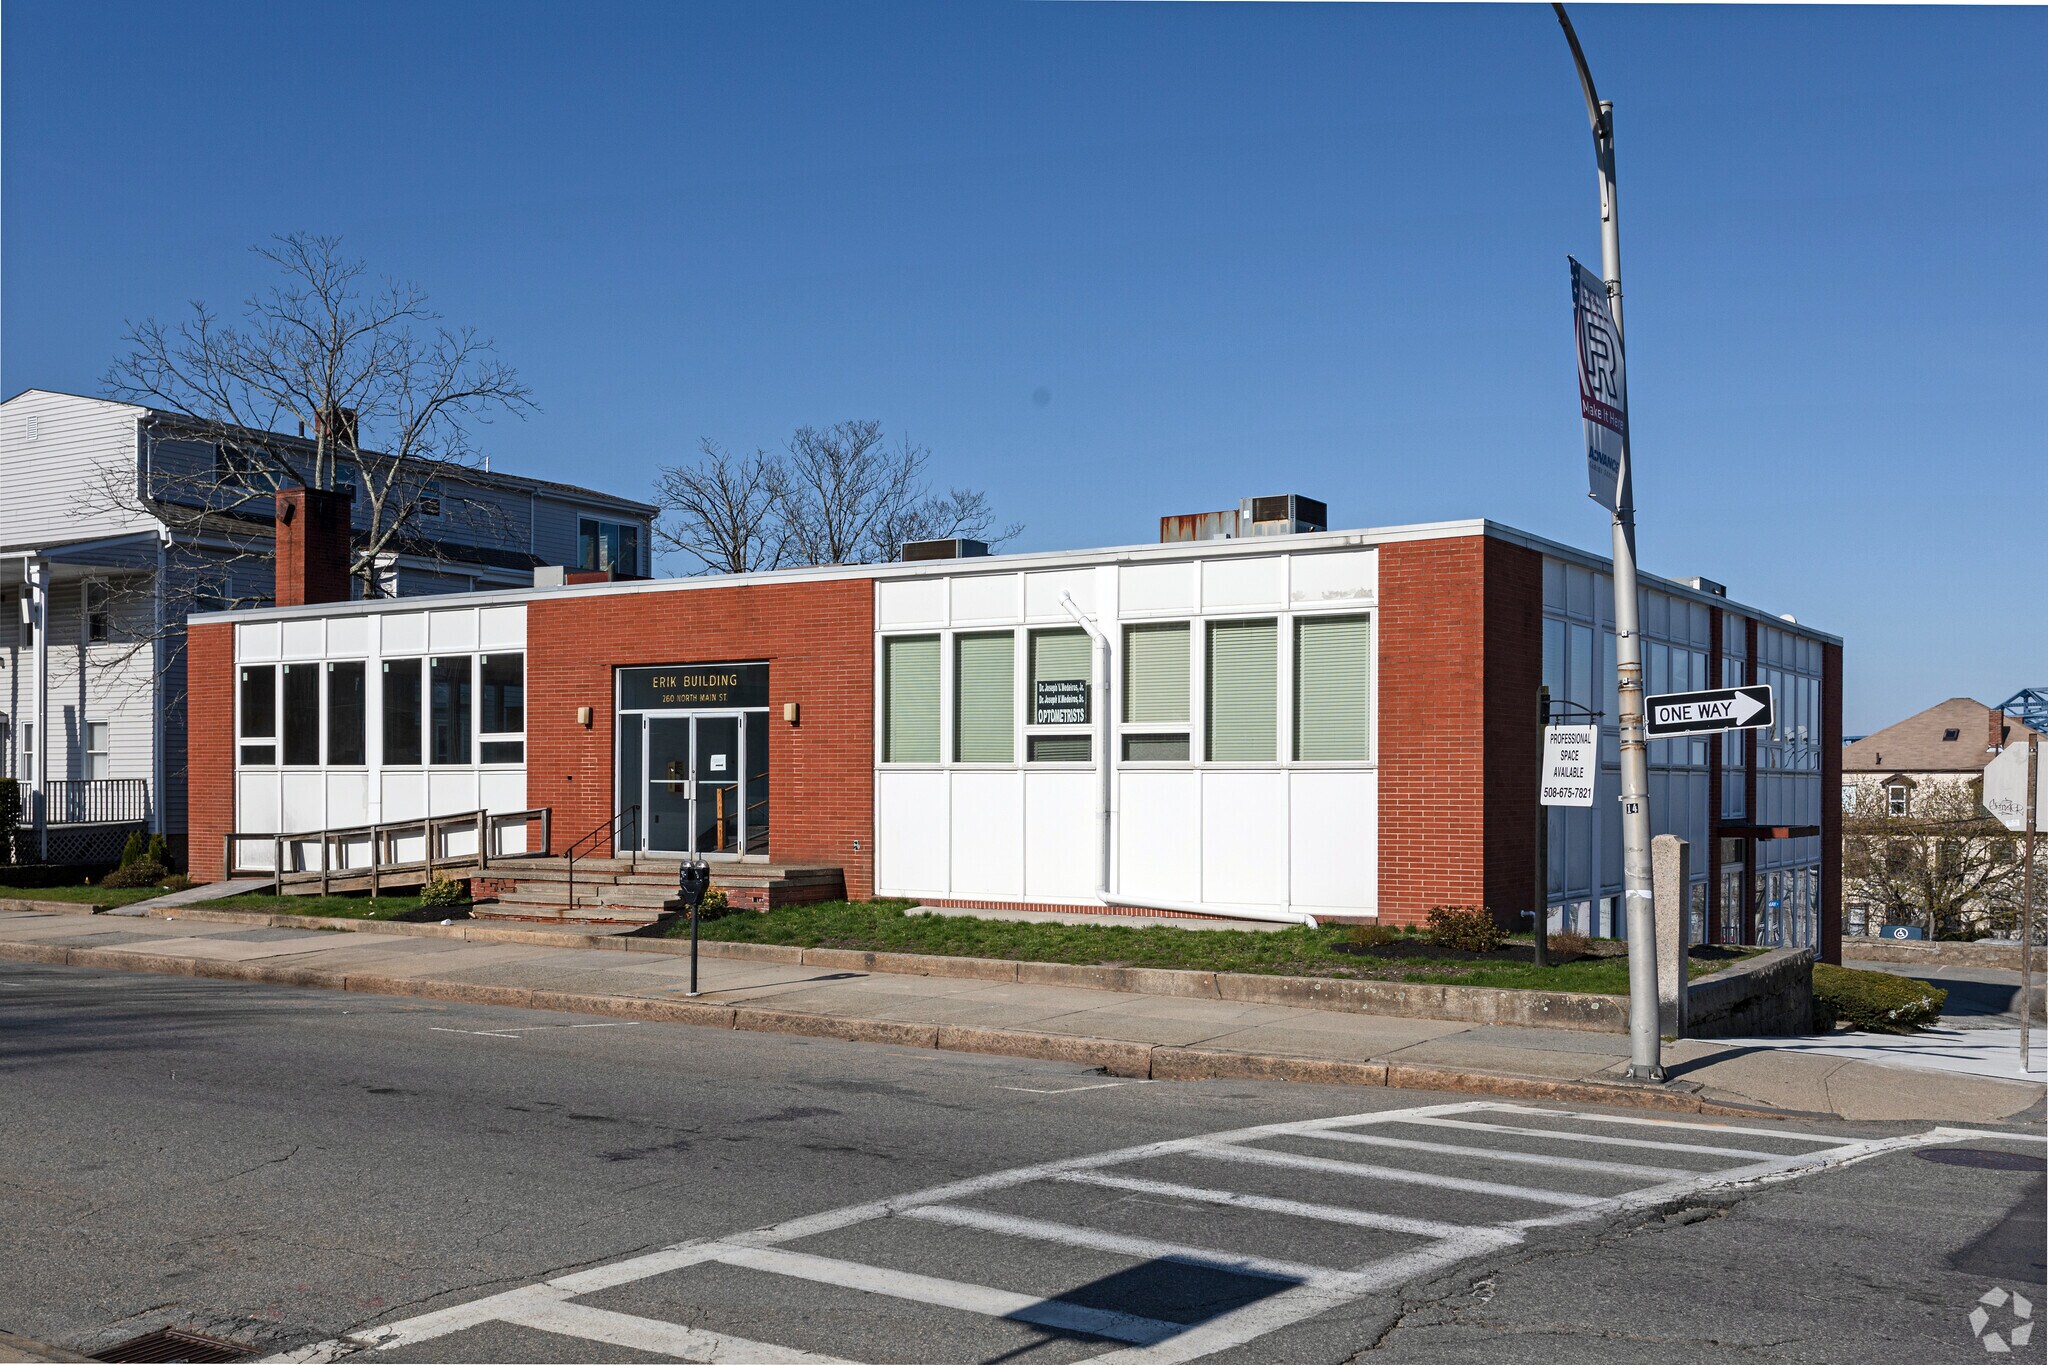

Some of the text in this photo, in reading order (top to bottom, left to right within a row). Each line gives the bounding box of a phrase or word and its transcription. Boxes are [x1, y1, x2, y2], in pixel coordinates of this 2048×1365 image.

[1582, 399, 1602, 420] Make
[1609, 412, 1624, 431] Here
[652, 674, 737, 688] ERIK BUILDING
[662, 694, 675, 703] 260
[677, 693, 698, 702] NORTH
[699, 693, 717, 702] MAIN
[1038, 708, 1085, 723] OPTOMETRISTS
[1660, 701, 1732, 722] ONE WAY
[1550, 733, 1591, 744] PROFESSIONAL
[1560, 749, 1579, 761] SPACE
[1553, 766, 1584, 778] AVAILABLE
[1543, 787, 1591, 798] 508-675-7821
[1627, 804, 1638, 814] 14
